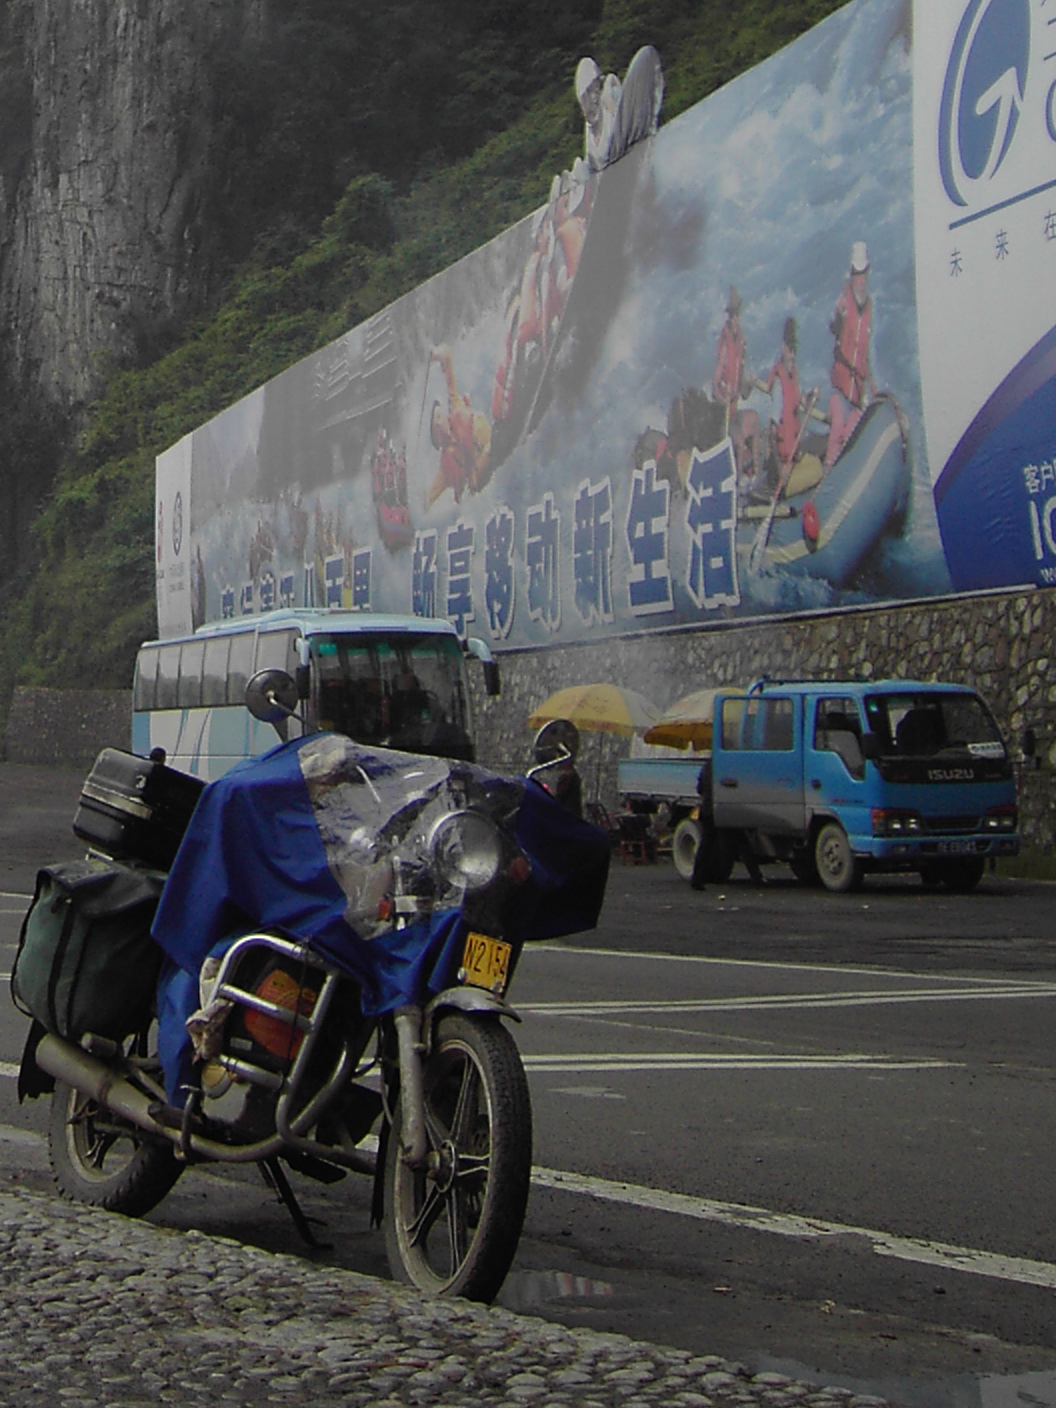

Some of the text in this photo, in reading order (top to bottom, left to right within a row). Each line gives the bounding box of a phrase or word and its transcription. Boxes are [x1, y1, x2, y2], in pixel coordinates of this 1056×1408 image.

[950, 209, 1056, 277] 未来在
[1023, 459, 1056, 494] 客户
[412, 438, 740, 641] 畅享移动新生活
[927, 768, 975, 780] ISUZU
